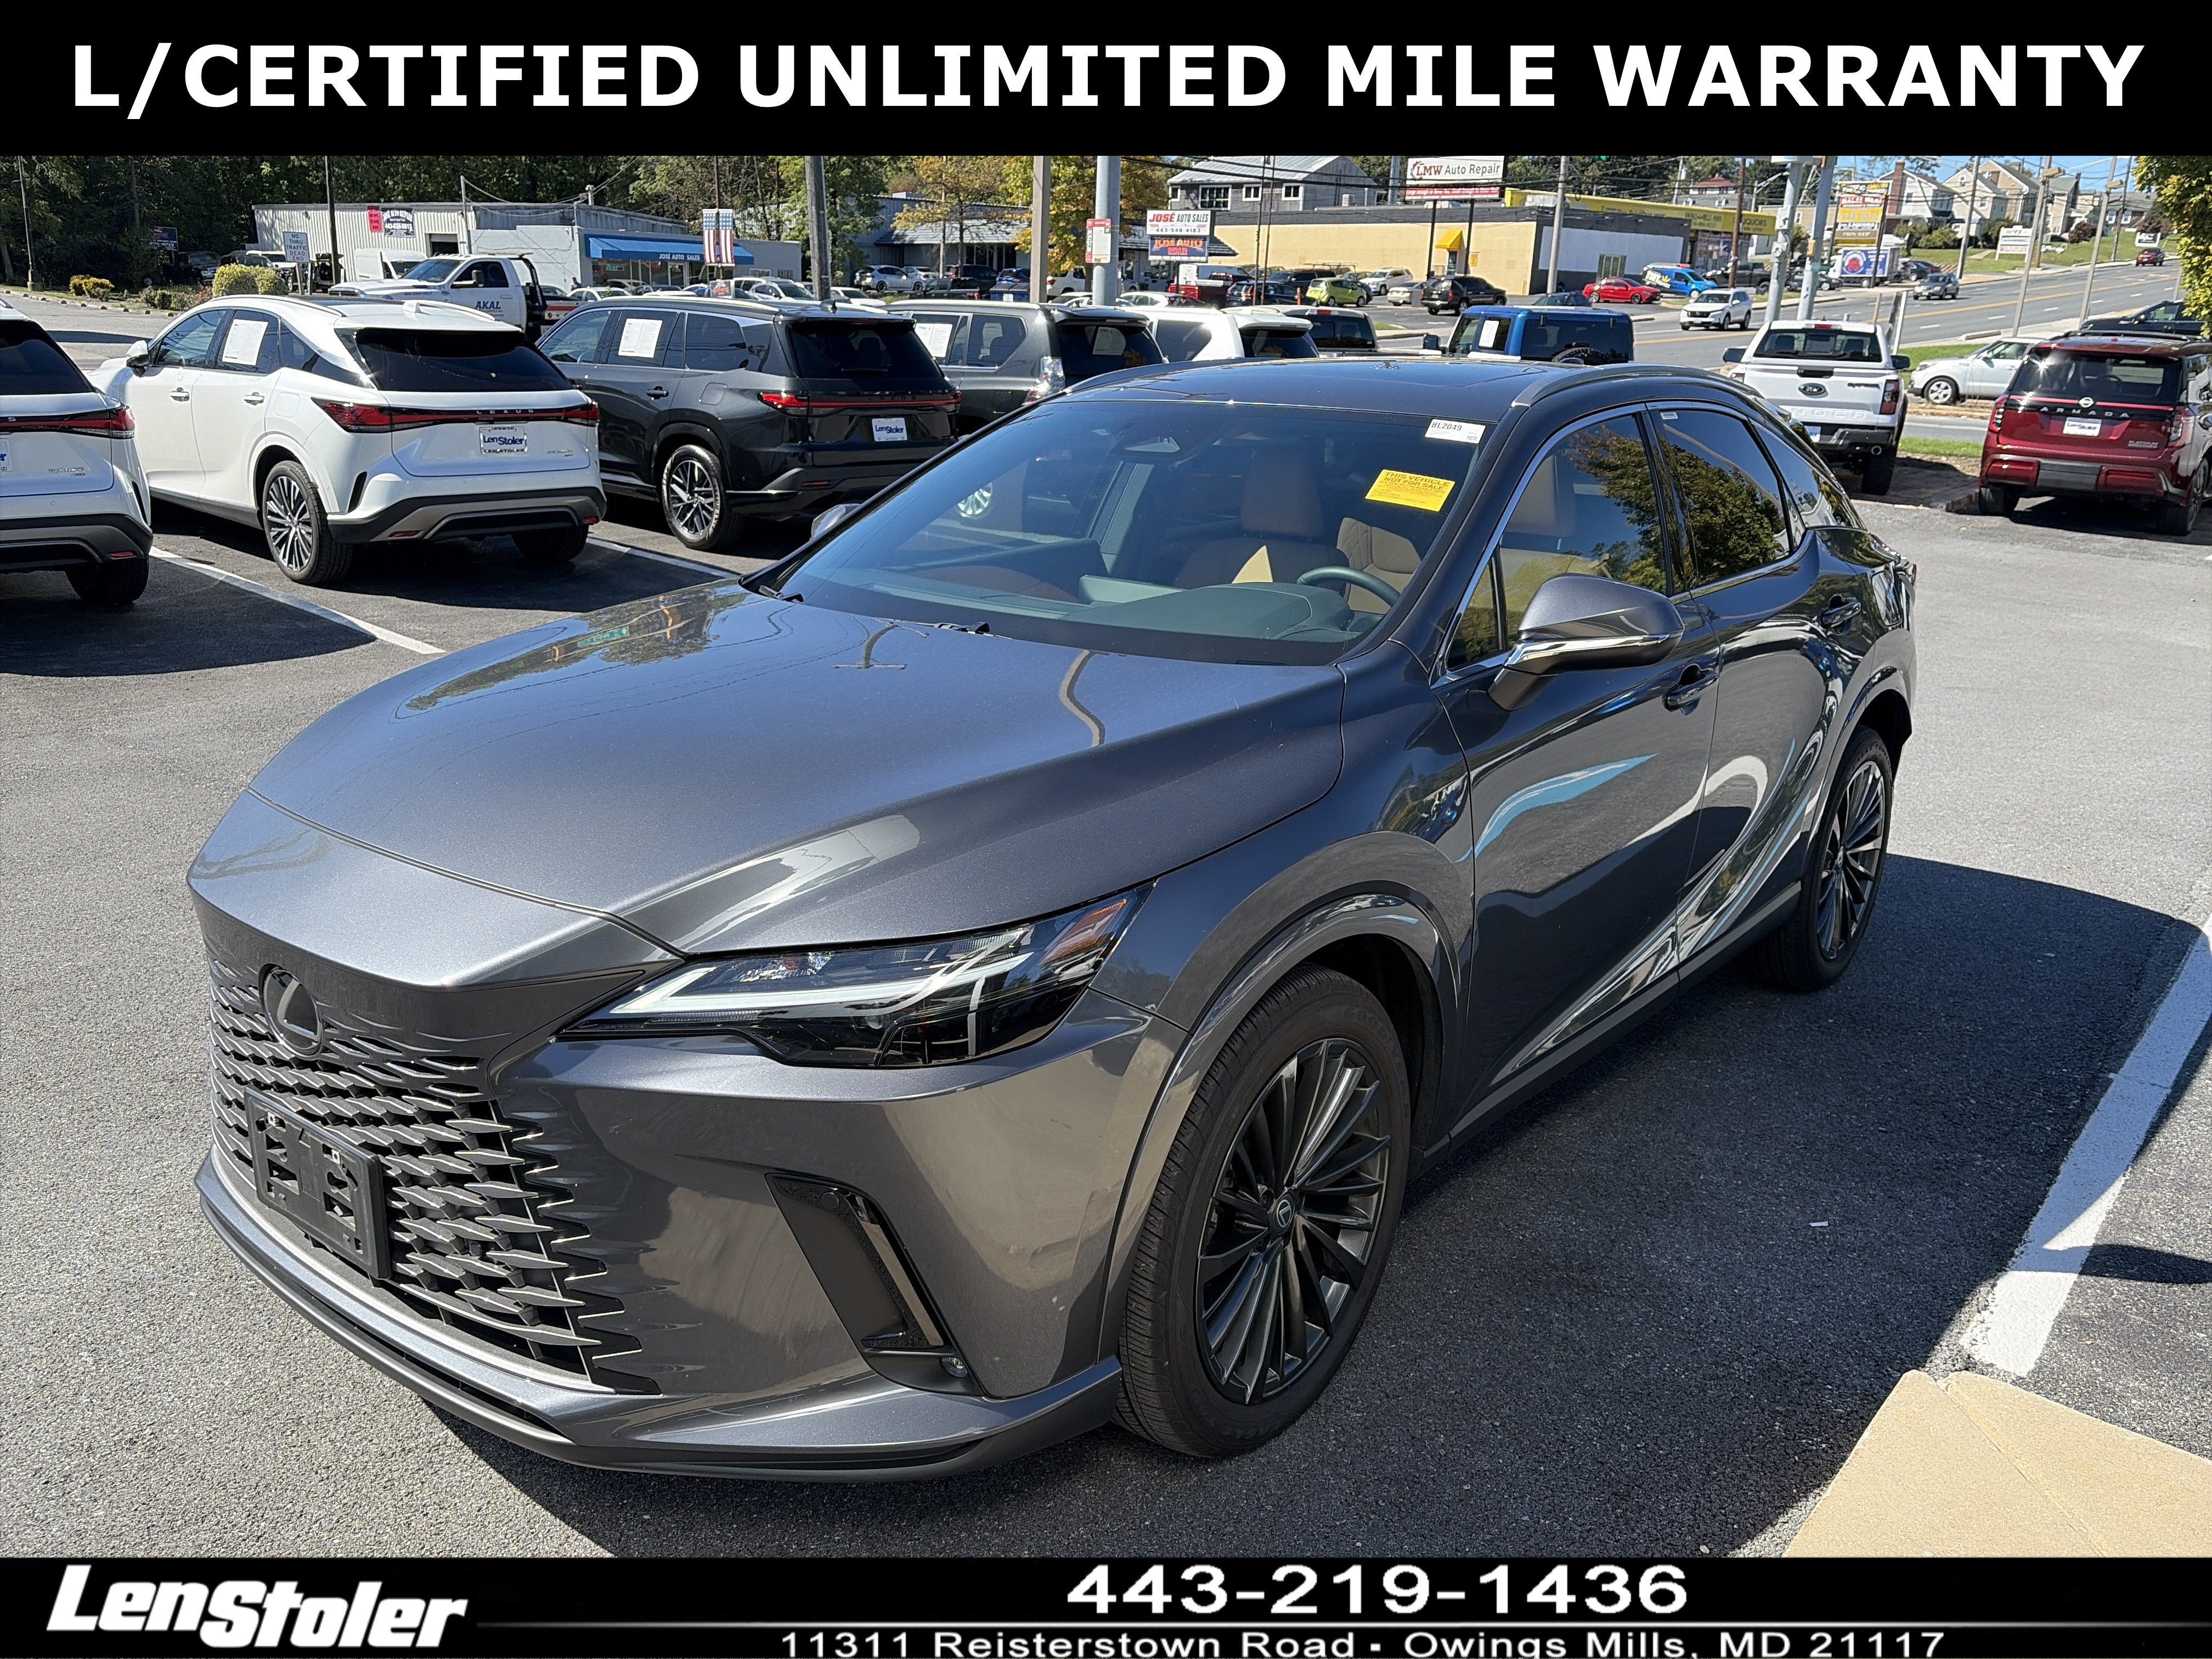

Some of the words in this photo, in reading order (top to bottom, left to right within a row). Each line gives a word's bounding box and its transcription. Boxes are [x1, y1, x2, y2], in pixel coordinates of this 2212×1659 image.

[1444, 165, 1466, 175] Auto
[1469, 163, 1500, 177] Repair
[1149, 212, 1176, 223] JOSÉ
[1176, 213, 1192, 223] AUTO
[1192, 213, 1209, 223] SALES
[475, 301, 501, 309] AKAL
[1791, 407, 1866, 419] NGER
[2040, 407, 2130, 417] ARMADA
[1409, 475, 1451, 487] VEHICLE
